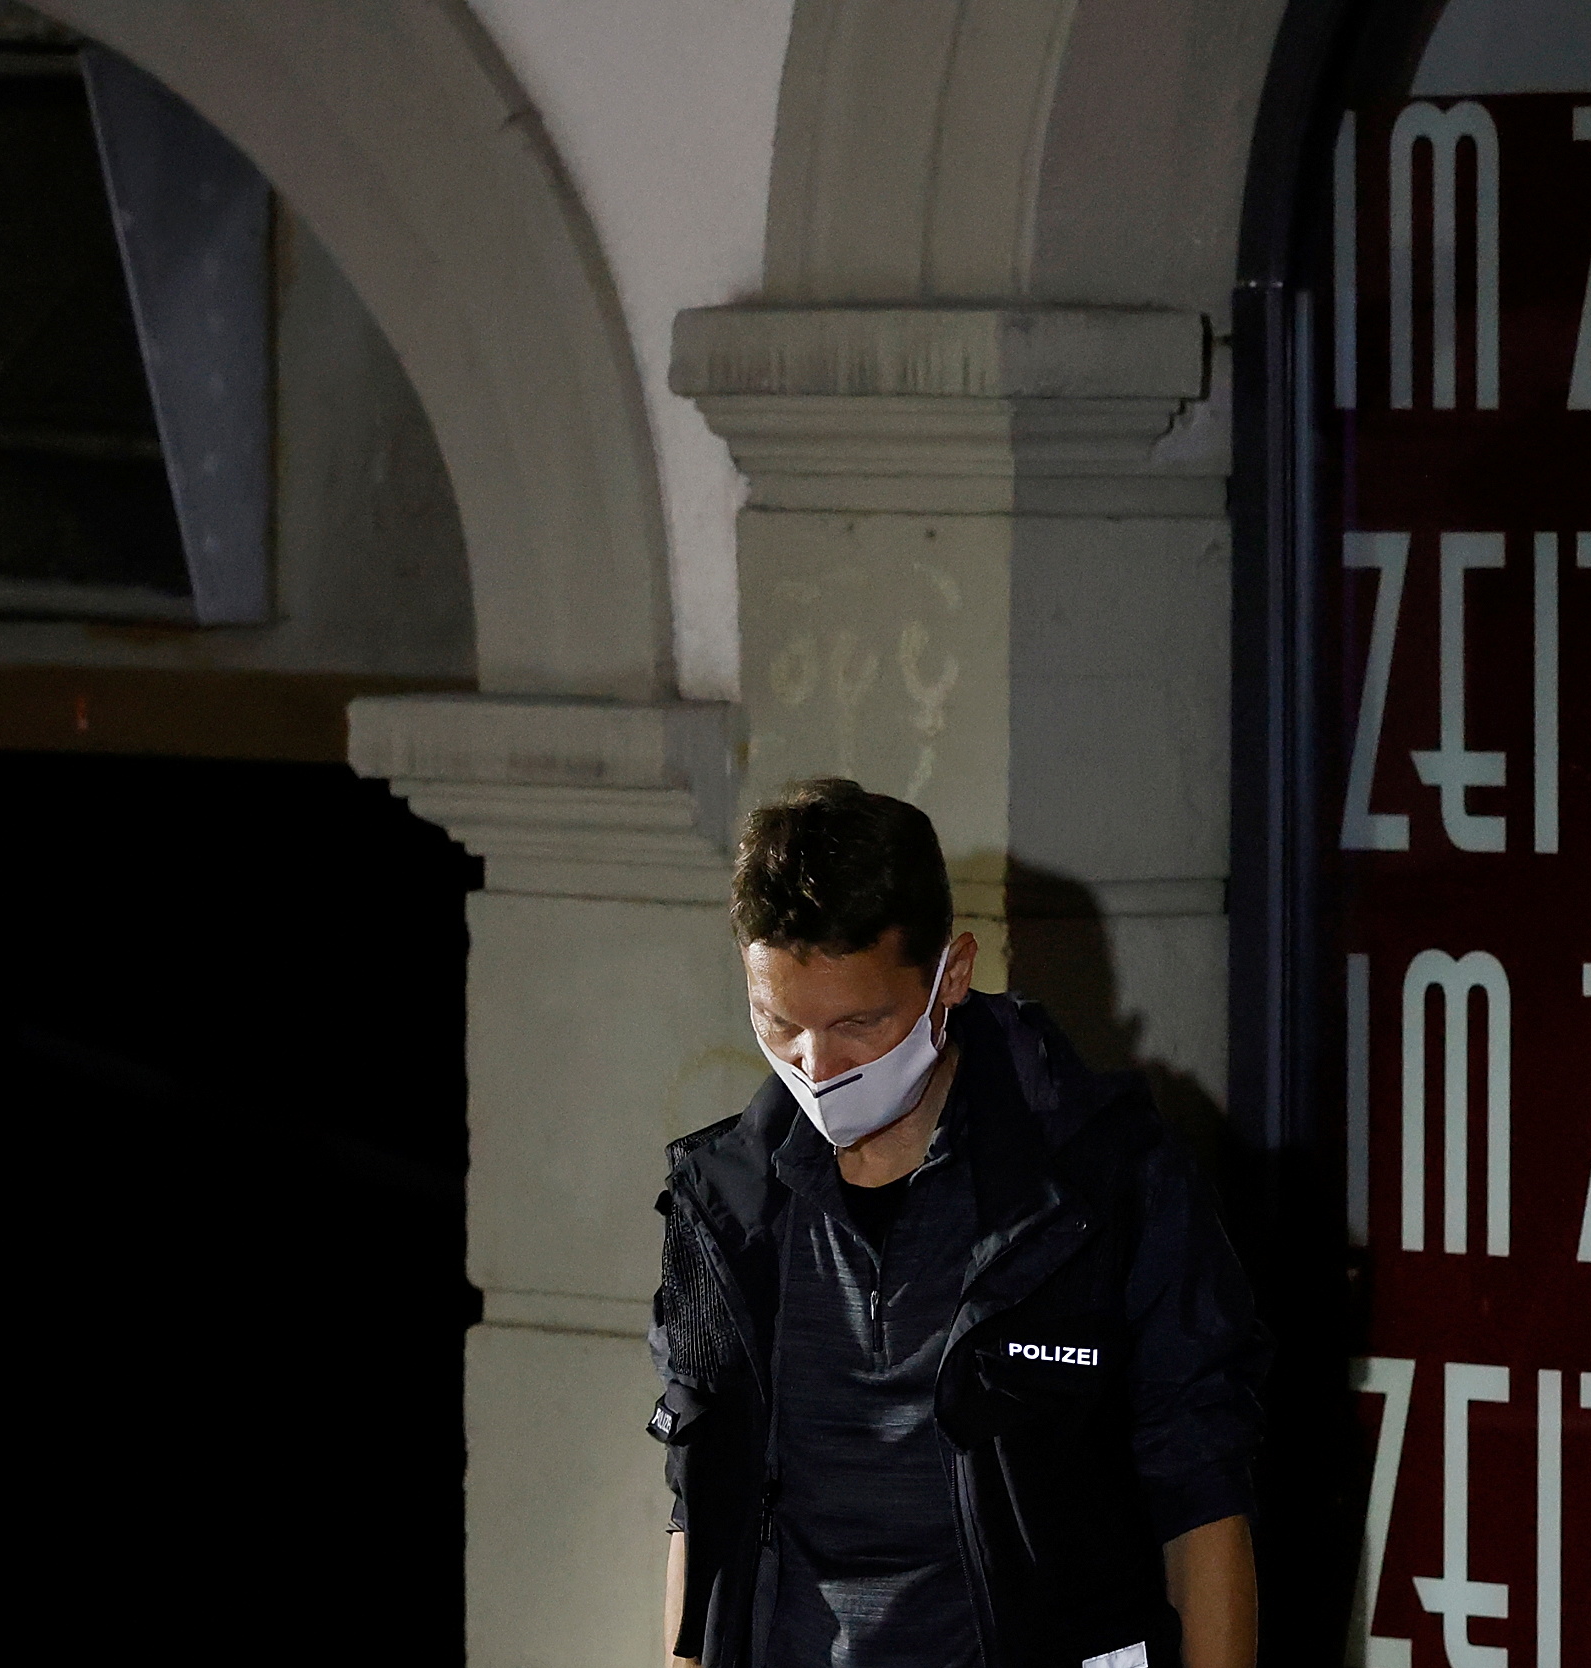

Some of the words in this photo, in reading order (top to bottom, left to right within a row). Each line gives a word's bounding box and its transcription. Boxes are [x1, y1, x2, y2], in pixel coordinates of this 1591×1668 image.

[1333, 100, 1500, 411] IM
[1347, 949, 1511, 1258] IM
[1008, 1342, 1098, 1366] POLIZEI
